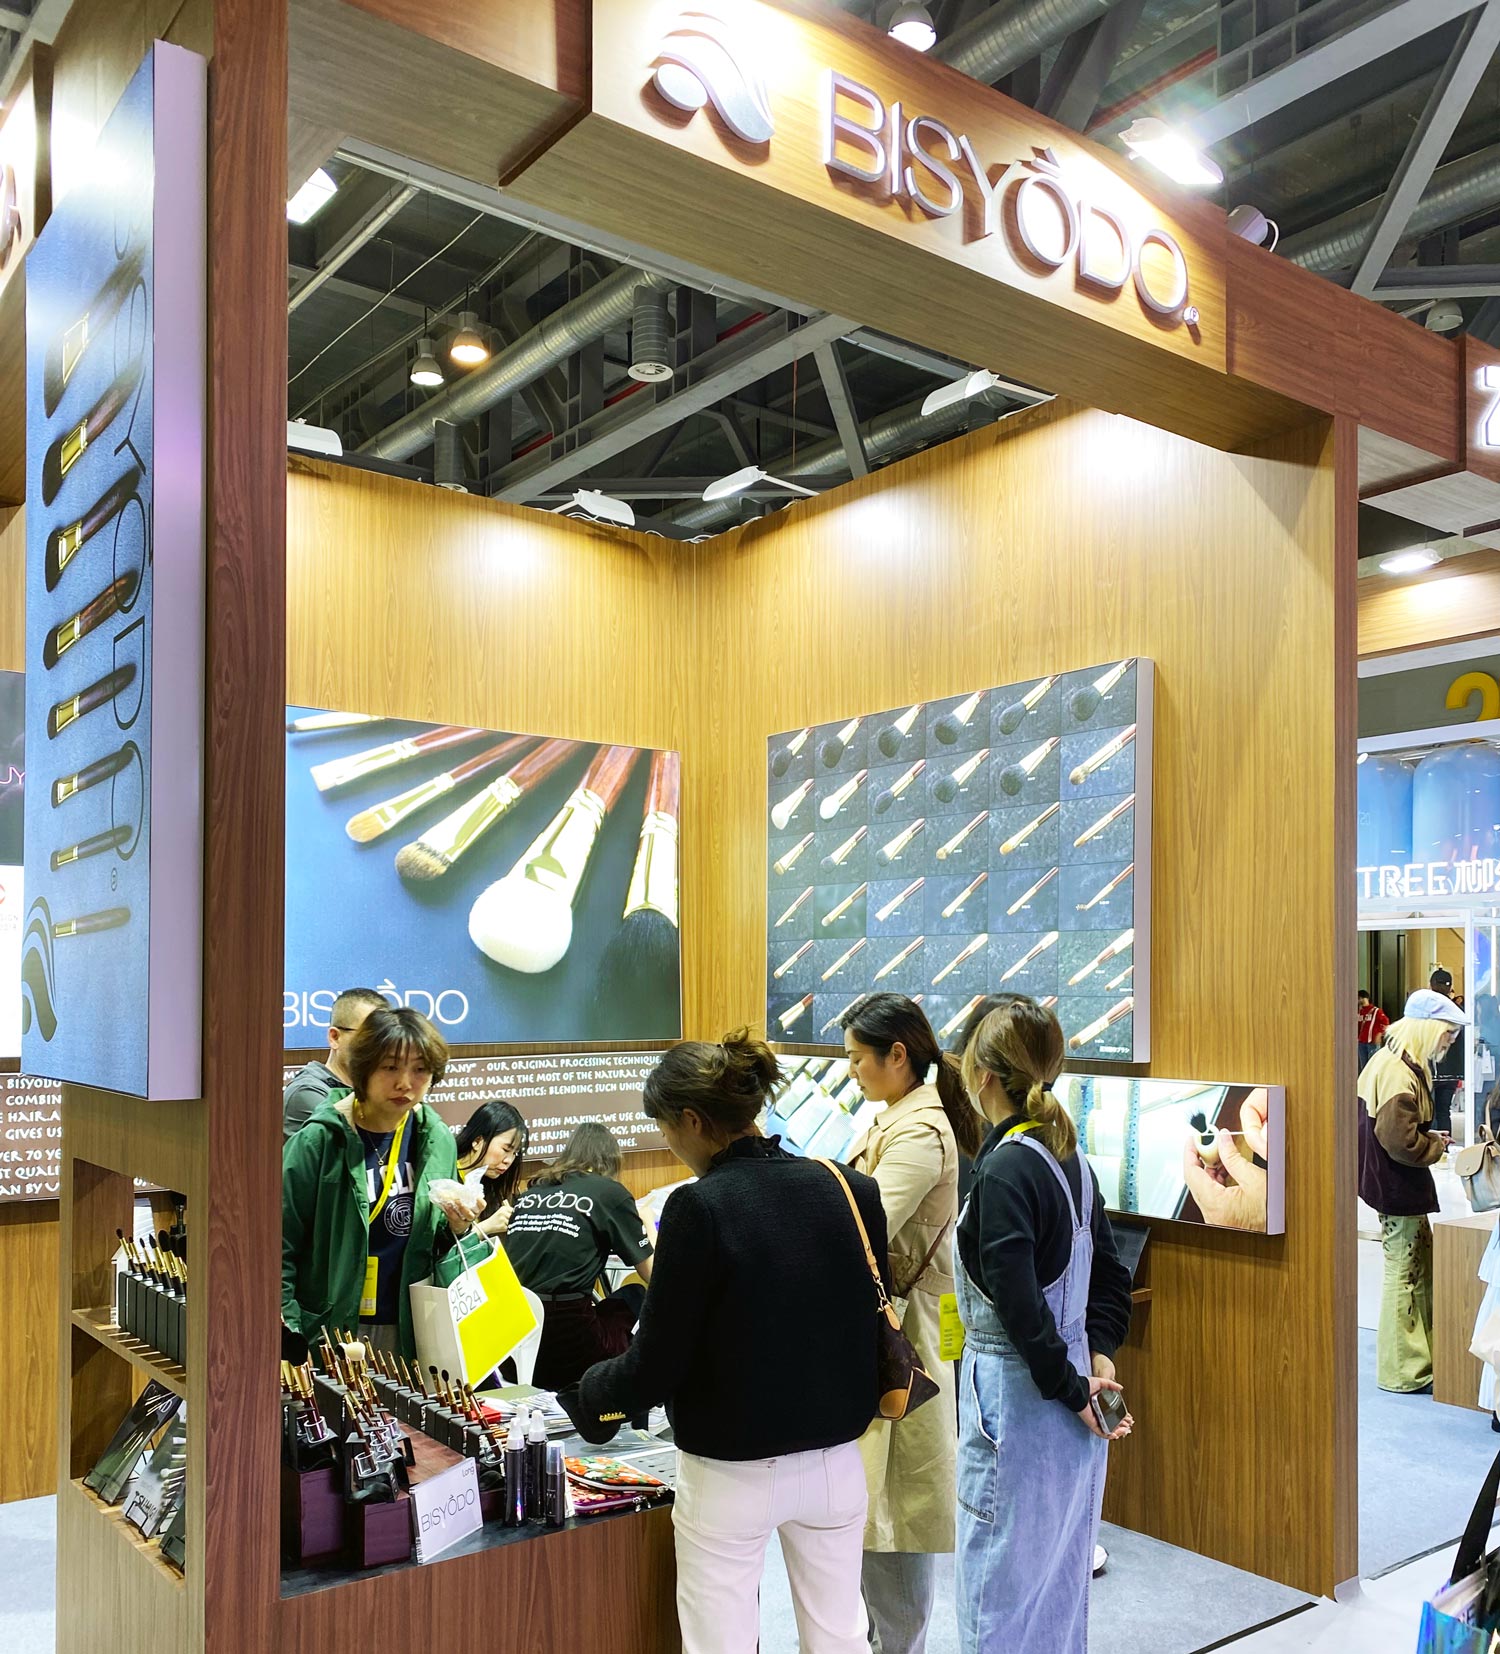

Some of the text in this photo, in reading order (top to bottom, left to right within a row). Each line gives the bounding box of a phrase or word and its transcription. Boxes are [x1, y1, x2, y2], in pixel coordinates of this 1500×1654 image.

[487, 1062, 509, 1072] OUR
[512, 1059, 558, 1070] ORIGINAL
[560, 1057, 612, 1068] PROCESSING
[471, 1077, 484, 1086] TO
[486, 1075, 514, 1085] MAKE
[517, 1074, 534, 1084] THE
[536, 1072, 560, 1082] MOST
[562, 1072, 574, 1081] OF
[576, 1071, 592, 1080] THE
[595, 1068, 638, 1080] NATURAL
[458, 1086, 546, 1100] CHARACTERISTICS:
[549, 1084, 593, 1095] BLENDING
[596, 1083, 616, 1092] SUCH
[532, 1116, 560, 1128] BRUSH
[619, 1112, 634, 1122] USE
[5, 1127, 42, 1140] GIVES
[541, 1130, 570, 1140] BRUSH
[26, 1149, 42, 1161] 70
[26, 1182, 42, 1194] BY
[453, 1290, 482, 1322] 2024
